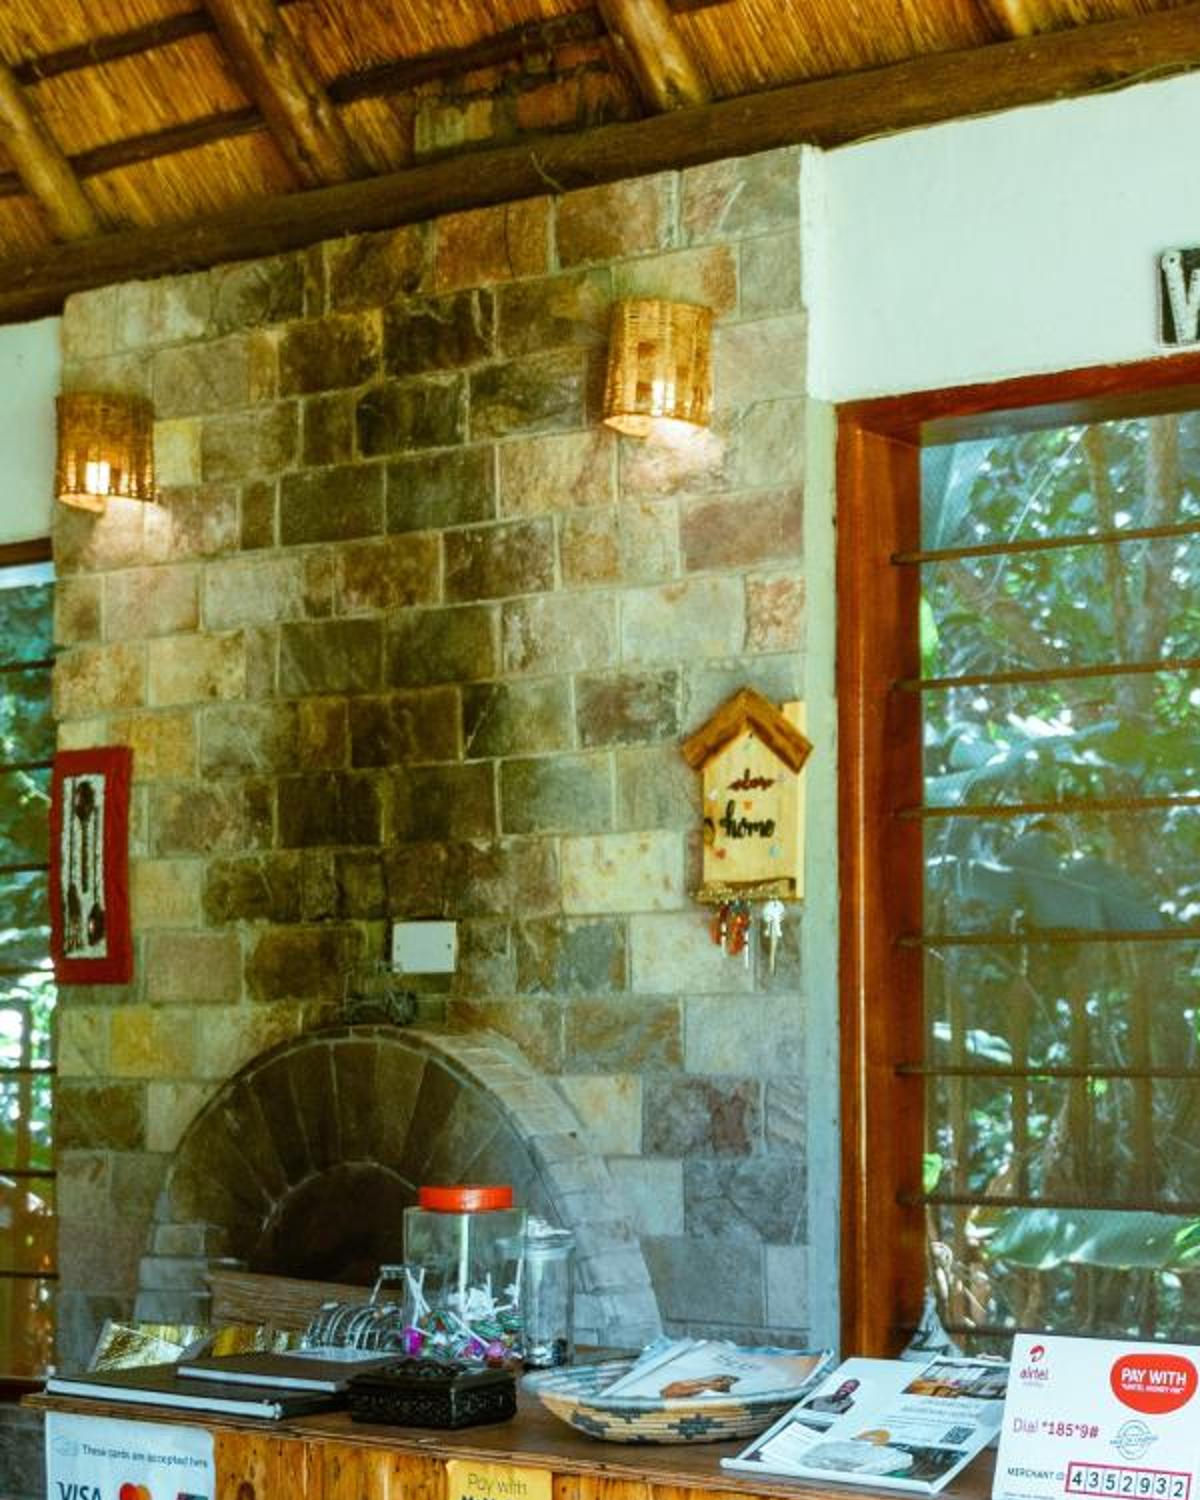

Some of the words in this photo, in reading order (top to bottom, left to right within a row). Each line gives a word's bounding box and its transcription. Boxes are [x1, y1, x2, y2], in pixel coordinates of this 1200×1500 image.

[1019, 1367, 1049, 1381] airtel
[1121, 1367, 1146, 1382] PAY
[1149, 1369, 1187, 1386] WITH
[1013, 1418, 1040, 1433] Dial
[467, 1473, 493, 1496] Pay
[497, 1480, 528, 1496] with
[1007, 1468, 1054, 1480] MERCHANT
[1071, 1471, 1184, 1498] 4352932
